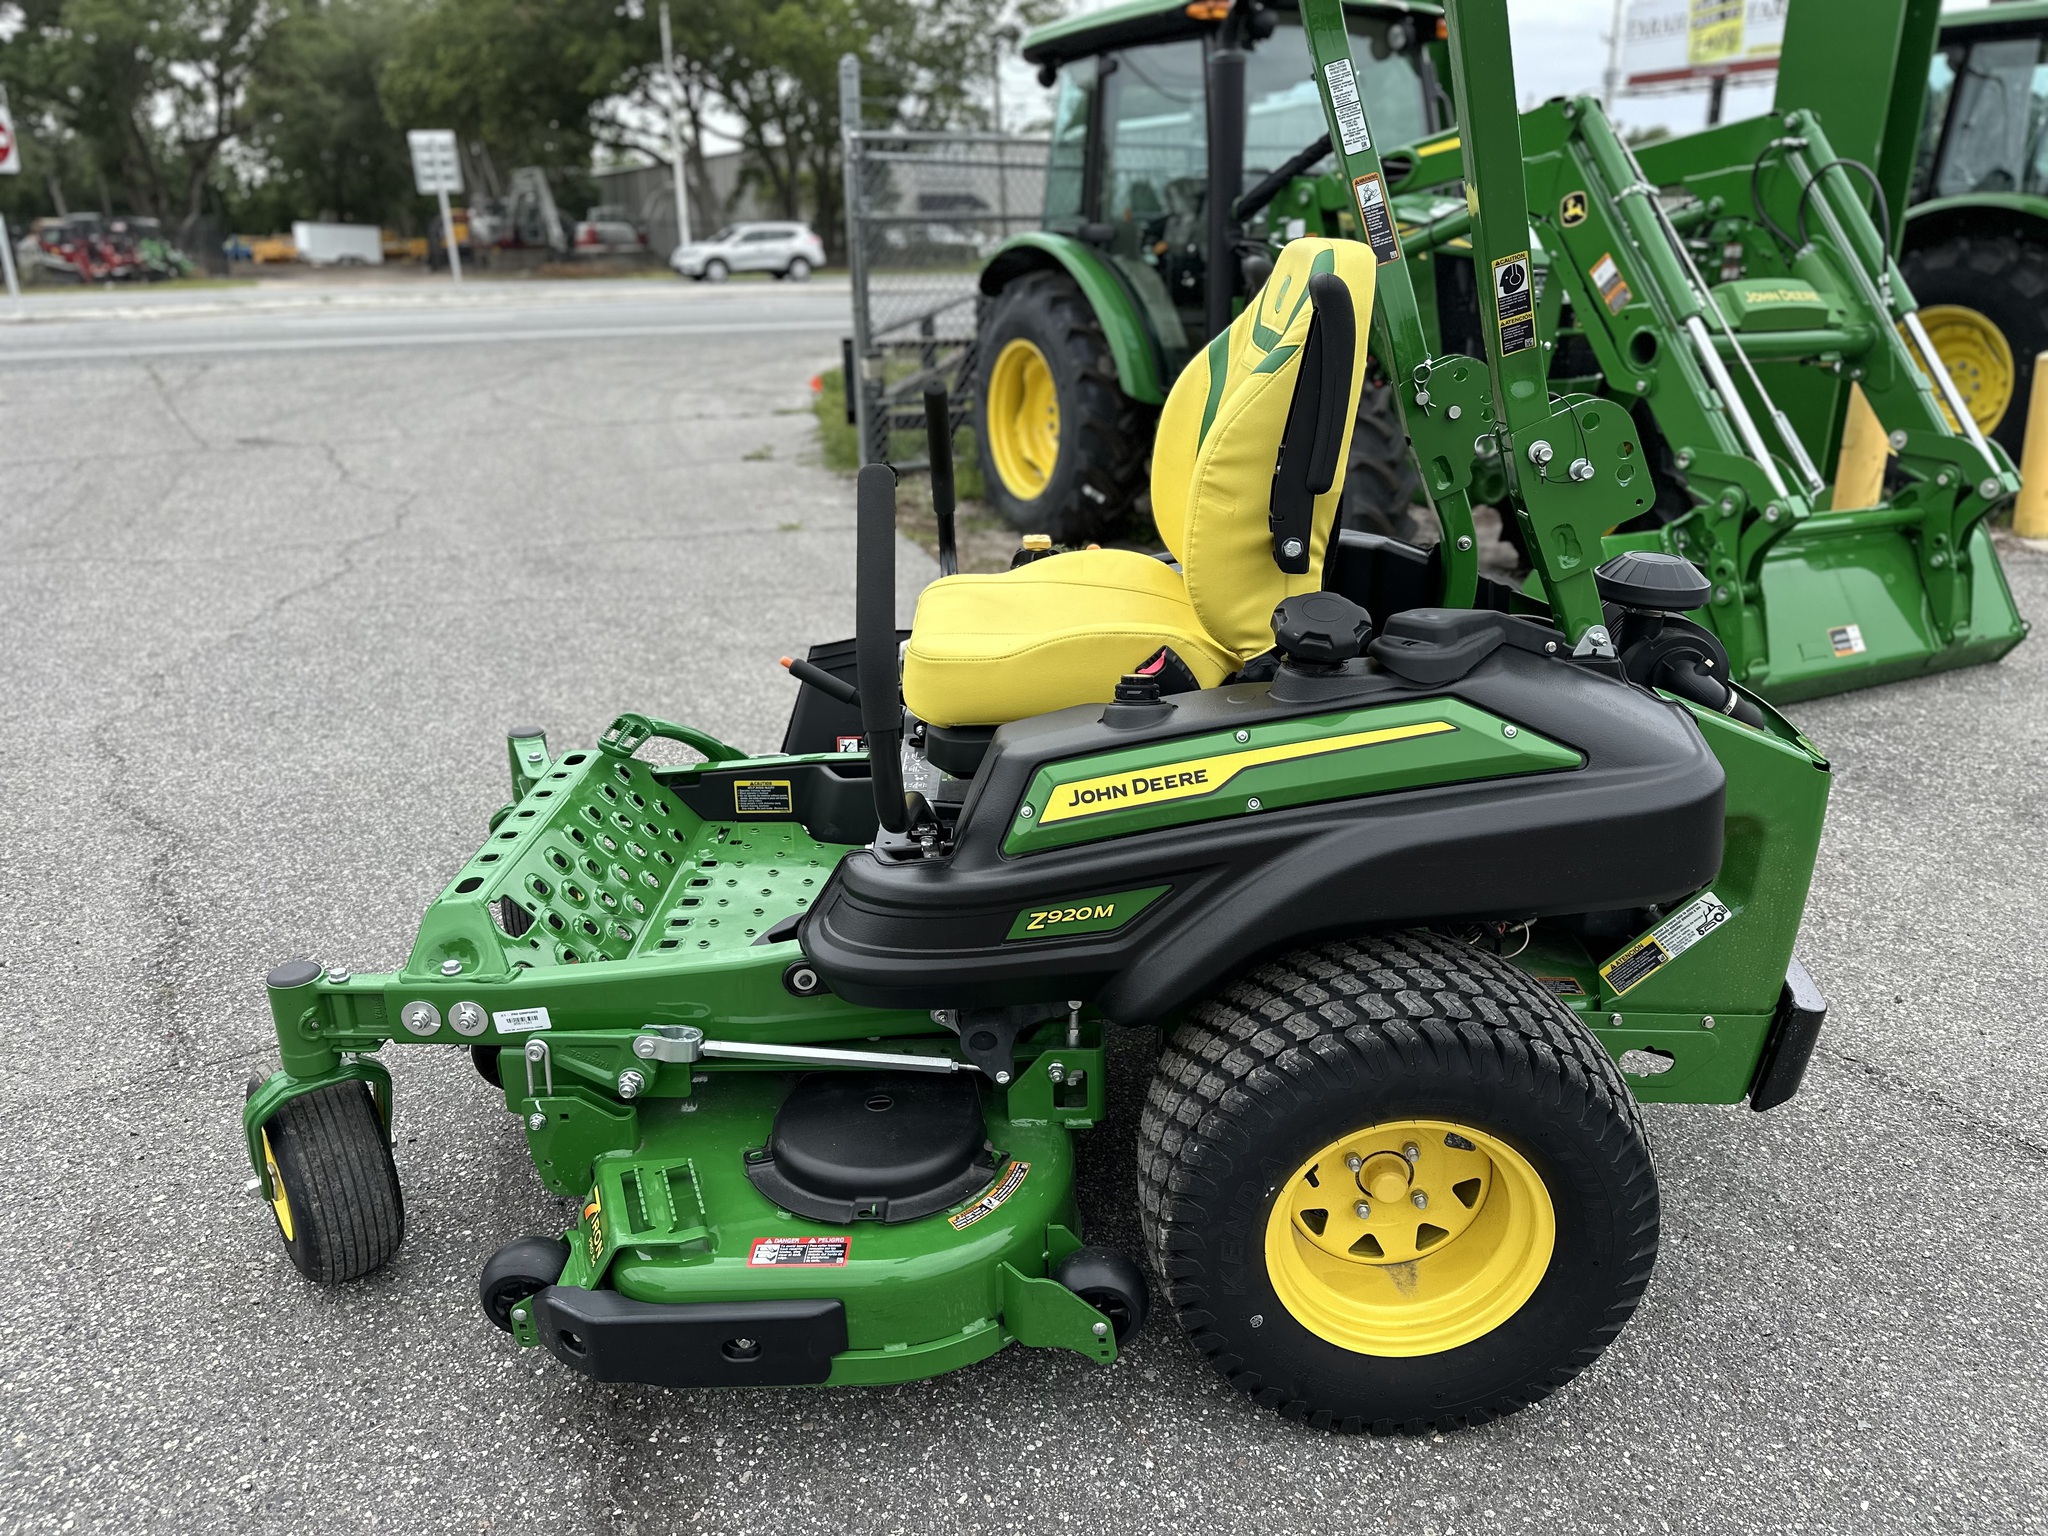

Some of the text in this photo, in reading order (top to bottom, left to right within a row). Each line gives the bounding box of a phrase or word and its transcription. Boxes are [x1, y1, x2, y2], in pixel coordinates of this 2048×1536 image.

[1500, 252, 1526, 265] CAUTION
[1745, 289, 1821, 304] JOHN DEERE
[1504, 312, 1533, 326] ATENCIÓN
[1068, 769, 1209, 807] JOHN DEERE
[1026, 903, 1115, 931] Z920M
[1615, 942, 1645, 967] ATENCIÓN
